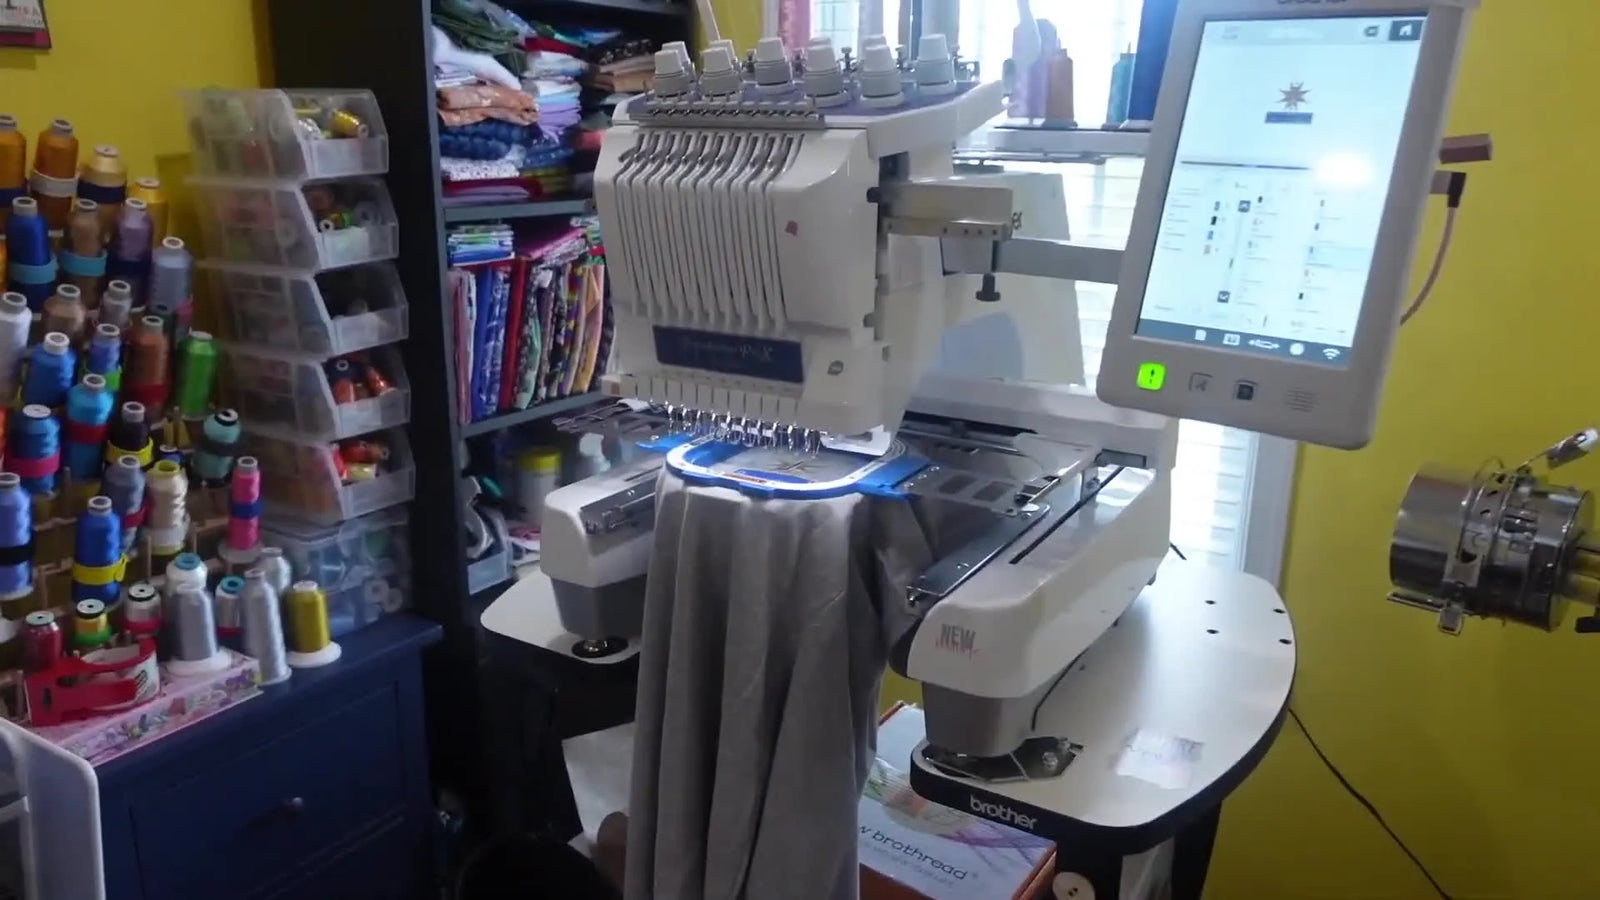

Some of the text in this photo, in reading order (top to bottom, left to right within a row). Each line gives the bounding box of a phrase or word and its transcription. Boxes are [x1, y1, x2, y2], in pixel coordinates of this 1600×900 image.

[940, 624, 976, 649] NEW
[970, 794, 1038, 830] brother
[872, 830, 968, 880] brothread
